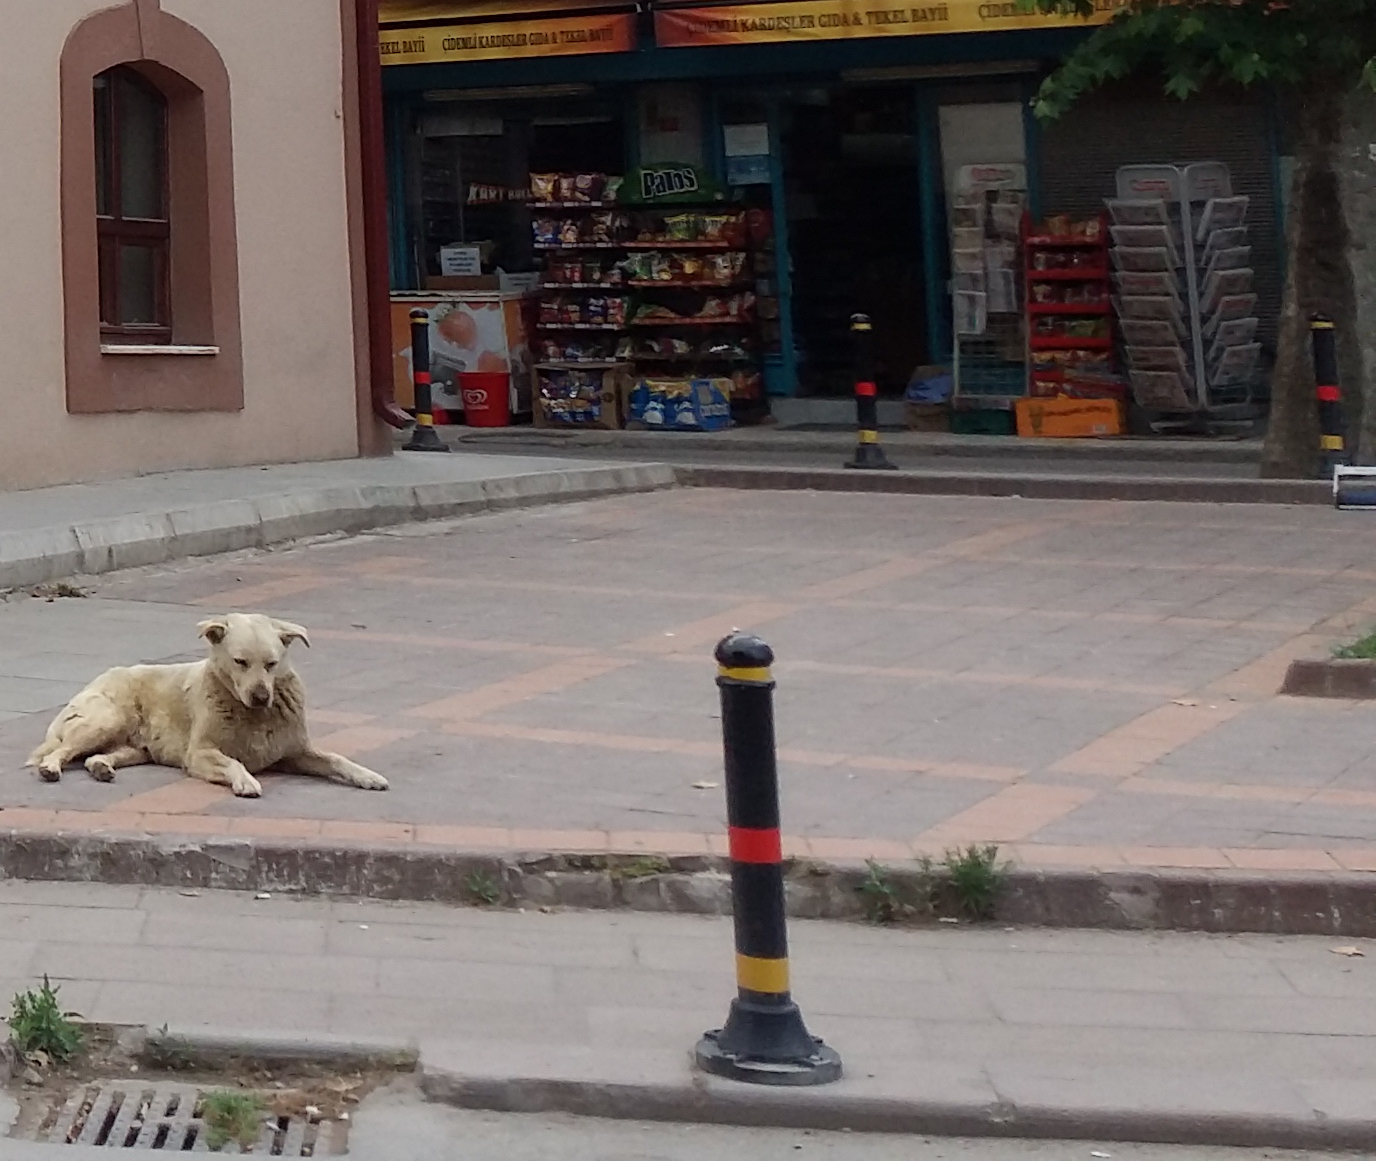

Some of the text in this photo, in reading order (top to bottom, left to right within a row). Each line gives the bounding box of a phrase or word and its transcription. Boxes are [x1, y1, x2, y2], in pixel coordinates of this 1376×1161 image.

[739, 14, 815, 33] KARDEŞLER
[818, 12, 850, 28] GIDA
[852, 11, 863, 25] &
[865, 9, 909, 25] TEKEL
[910, 2, 948, 22] BAYİİ
[380, 41, 401, 55] EKEL
[442, 33, 477, 54] ÇİDEMLİ
[478, 32, 528, 50] KARDEŞLER
